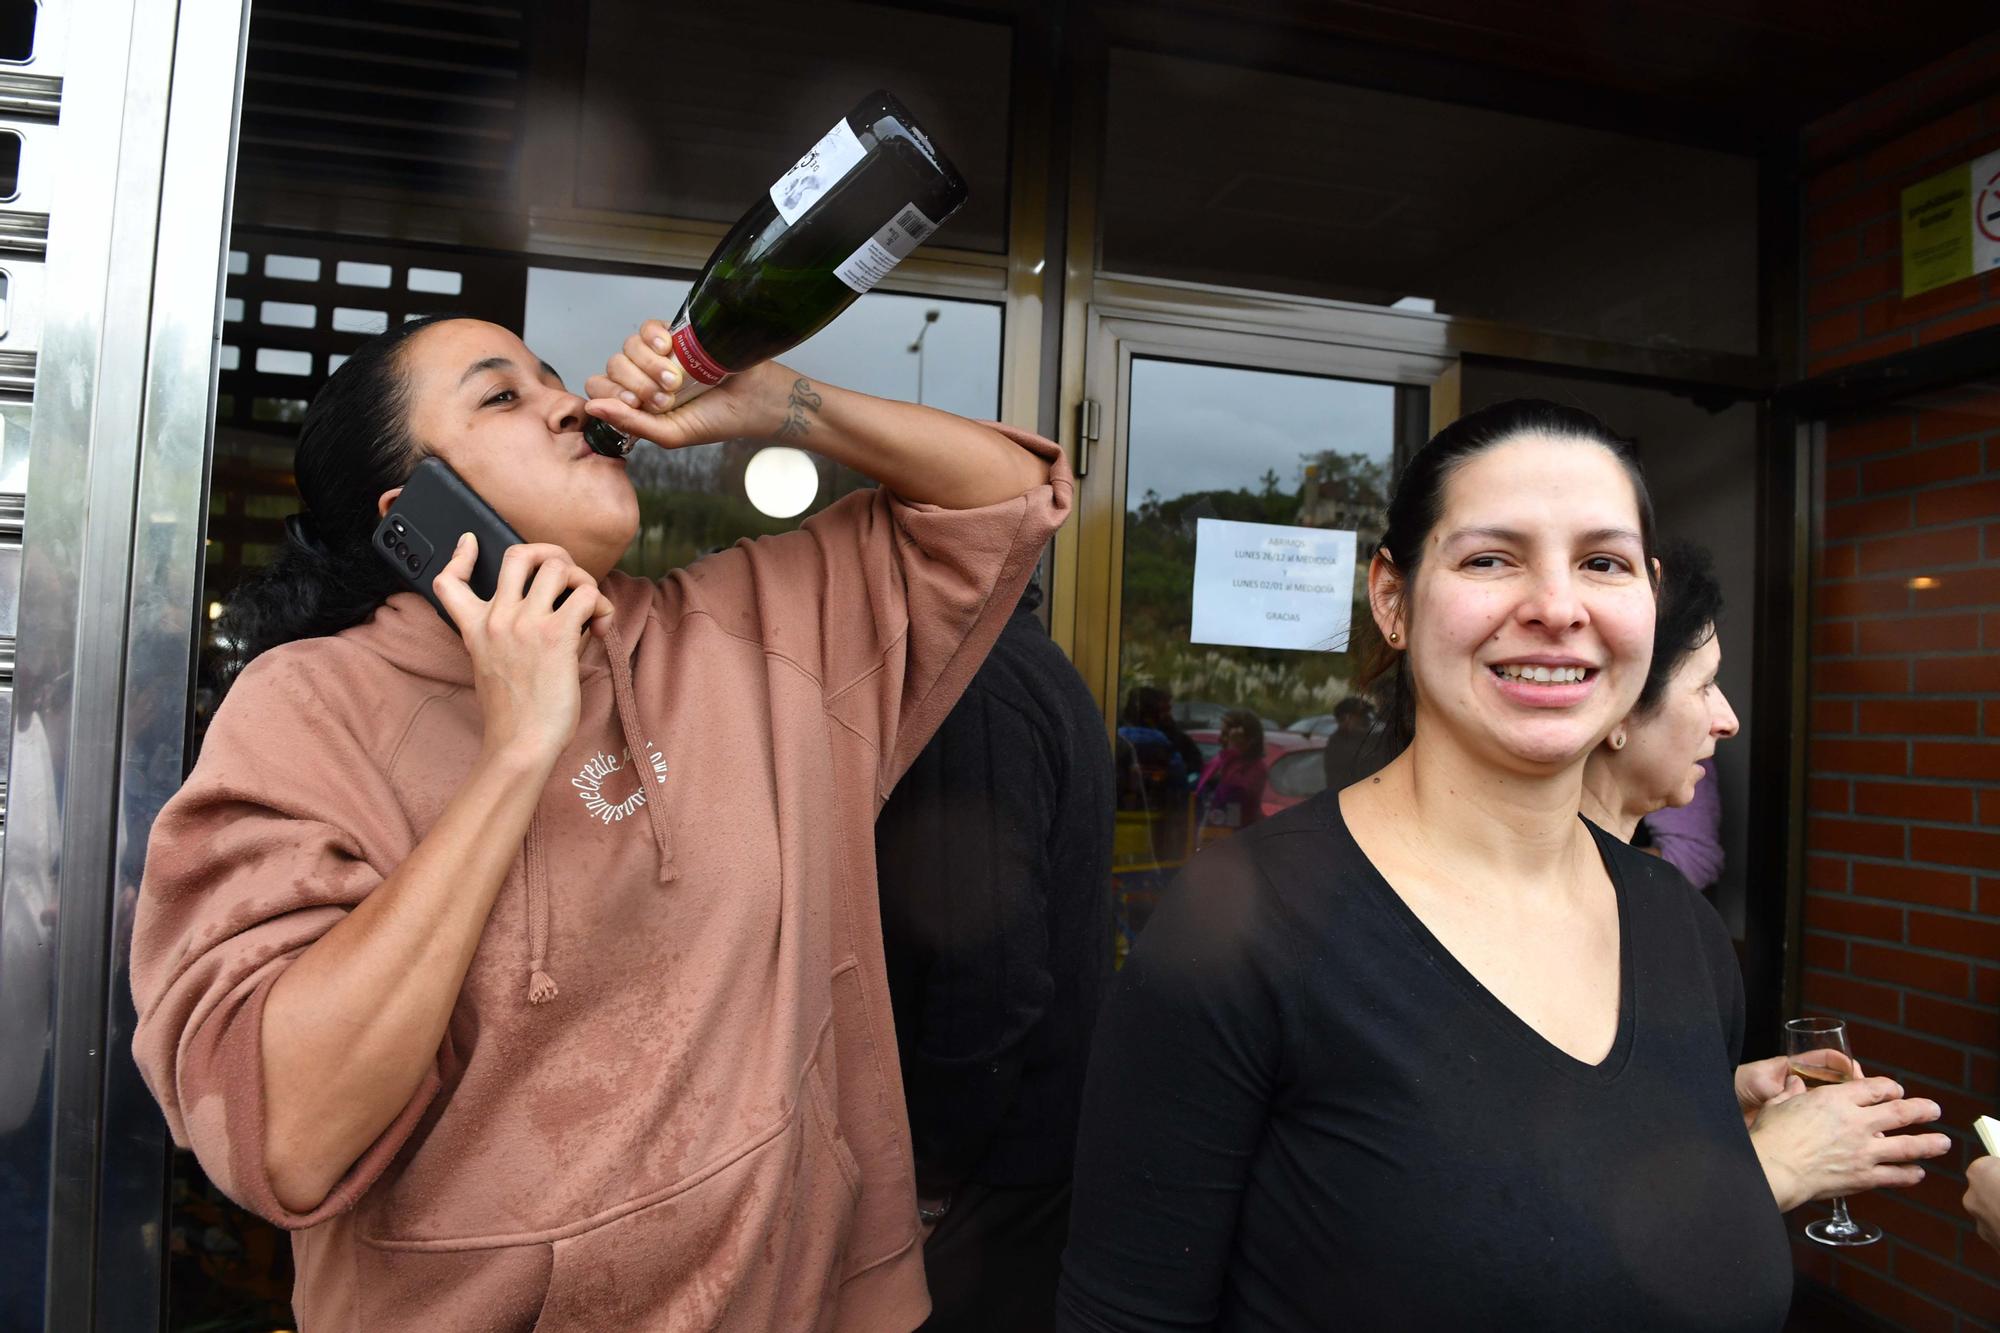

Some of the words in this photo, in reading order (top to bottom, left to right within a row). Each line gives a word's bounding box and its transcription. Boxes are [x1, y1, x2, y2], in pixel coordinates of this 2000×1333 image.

[1268, 537, 1305, 548] ABRIMOS
[1234, 549, 1260, 561] LUNES
[1262, 551, 1286, 563] 26/12
[1287, 553, 1294, 563] al
[1232, 578, 1258, 590] LUNES
[1259, 580, 1283, 592] 02/01
[1285, 582, 1292, 592] al
[1265, 611, 1301, 622] GRACIAS
[571, 750, 621, 792] Create
